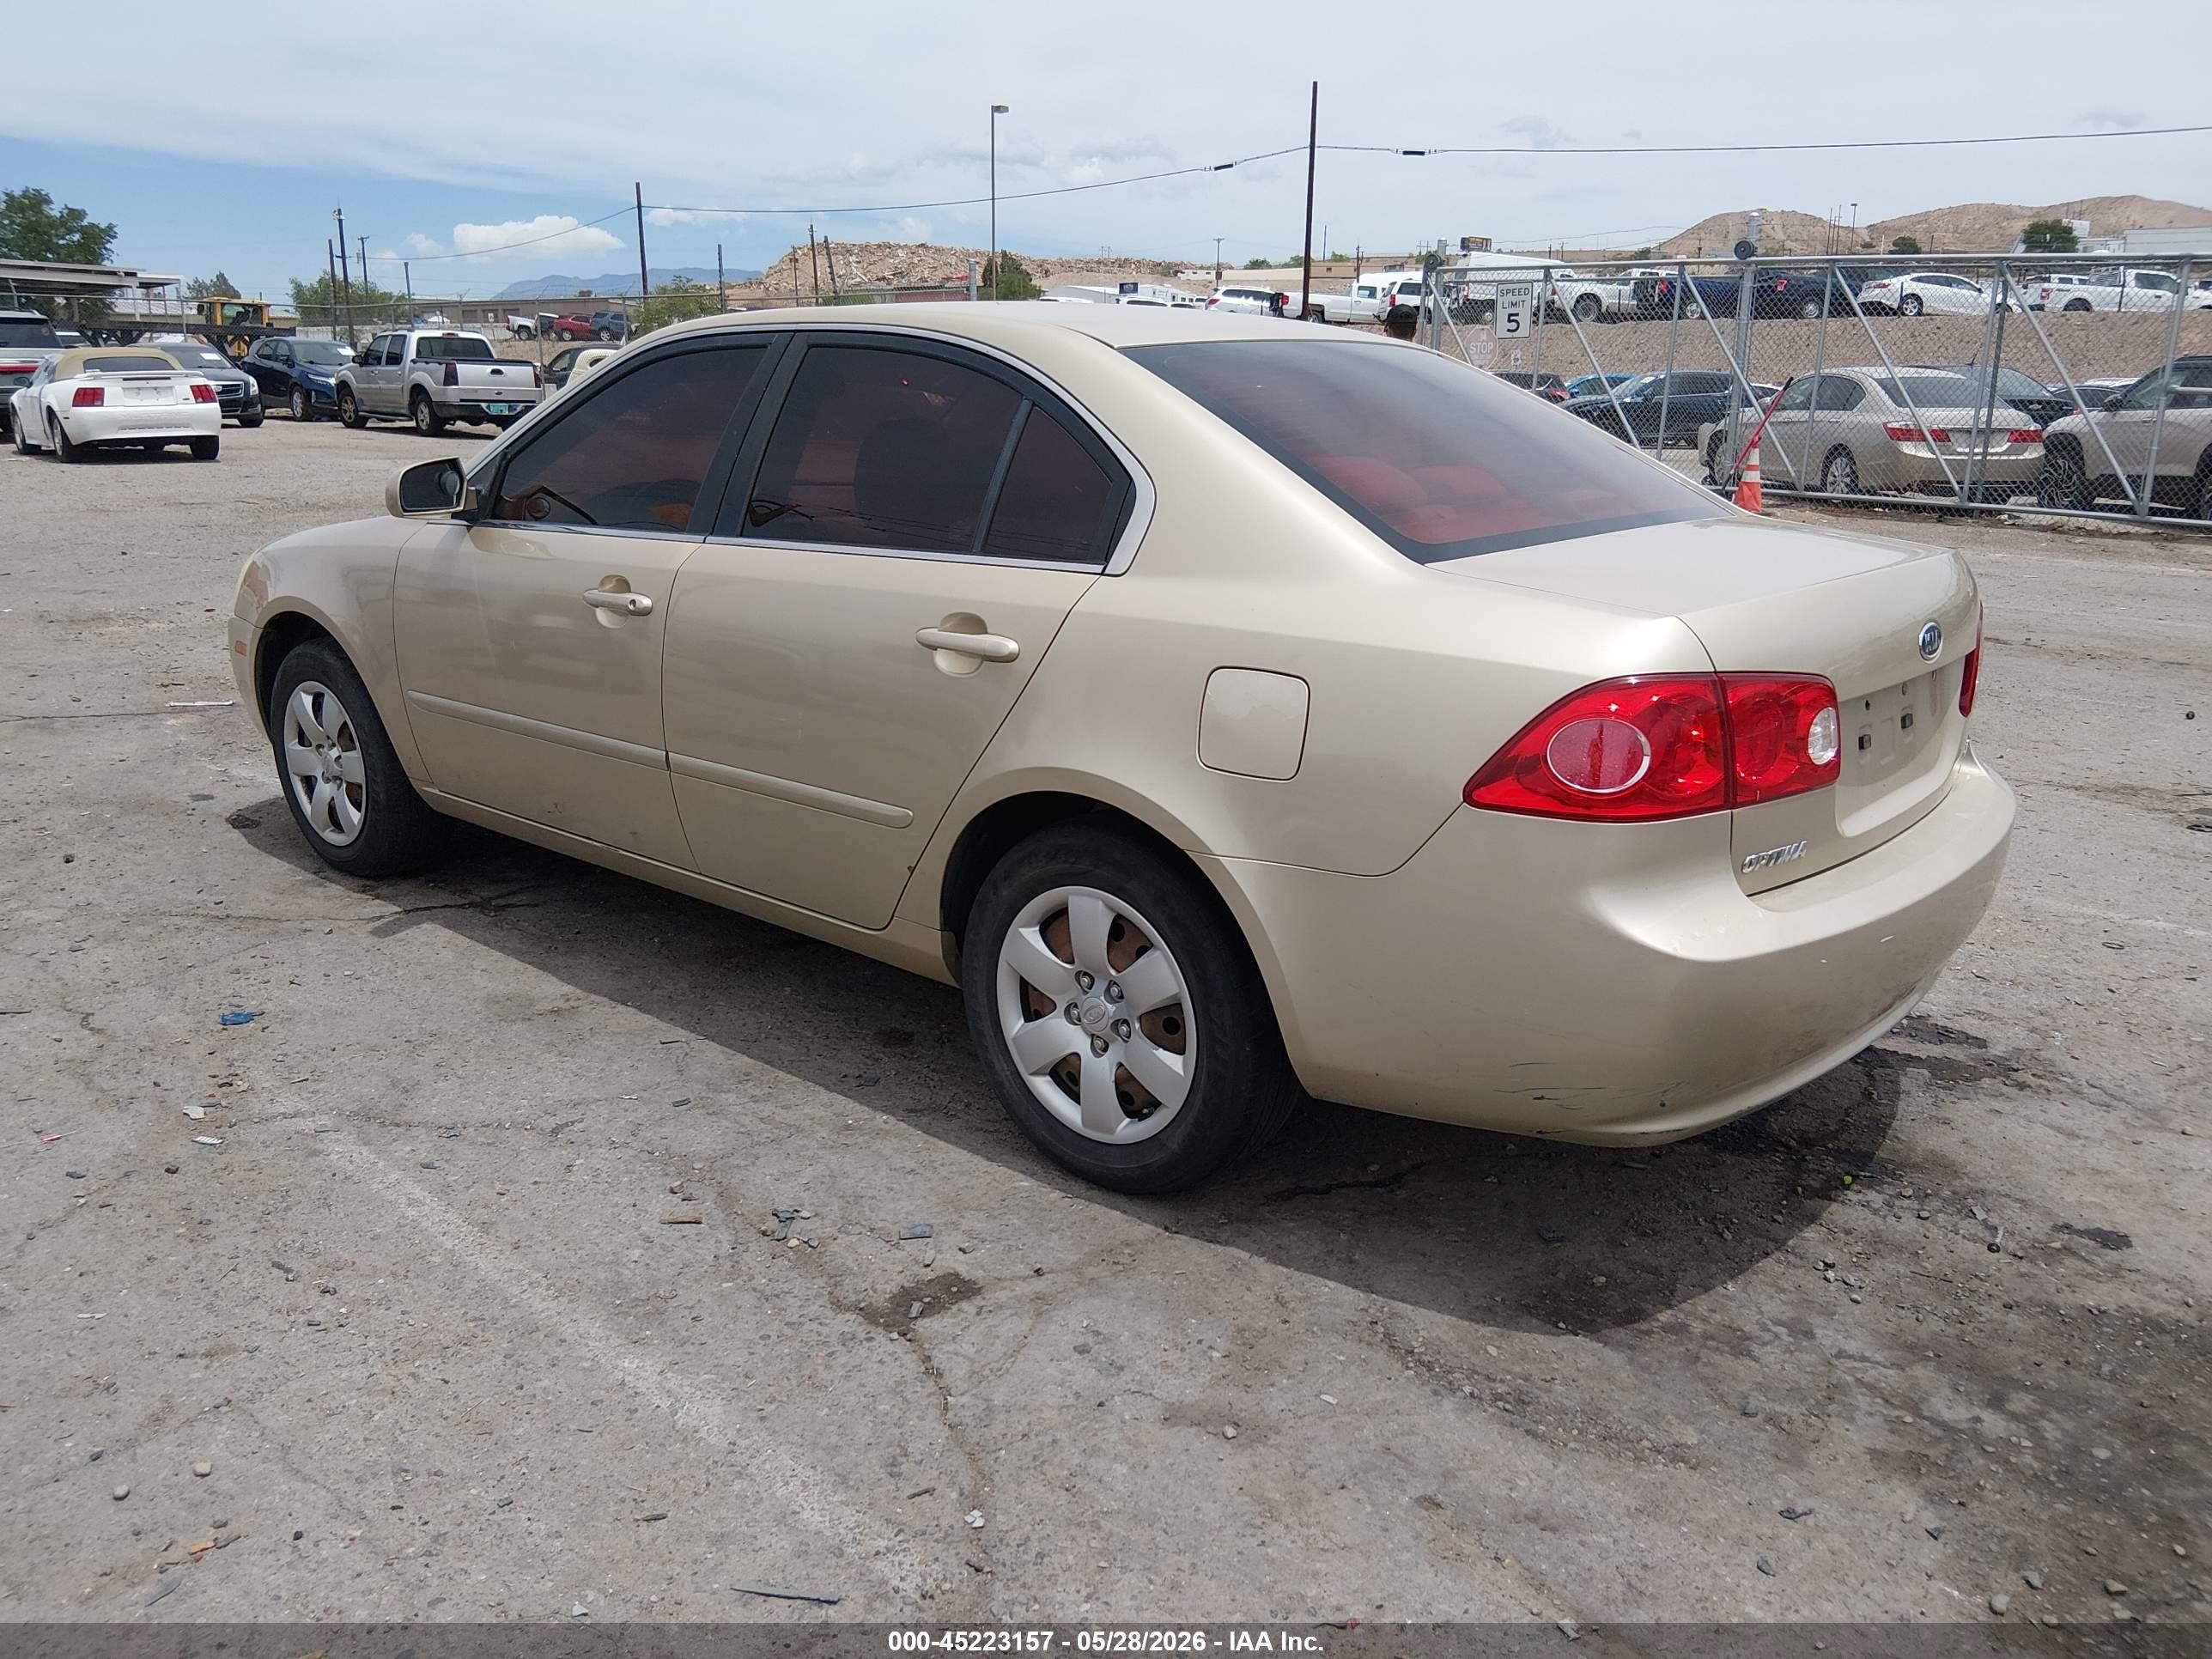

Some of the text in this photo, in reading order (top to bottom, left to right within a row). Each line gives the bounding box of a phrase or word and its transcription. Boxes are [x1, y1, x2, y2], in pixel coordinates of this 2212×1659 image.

[1499, 288, 1530, 297] SPEED
[1502, 300, 1526, 309] LIMIT
[1506, 312, 1521, 333] 5
[1469, 343, 1494, 354] STOP
